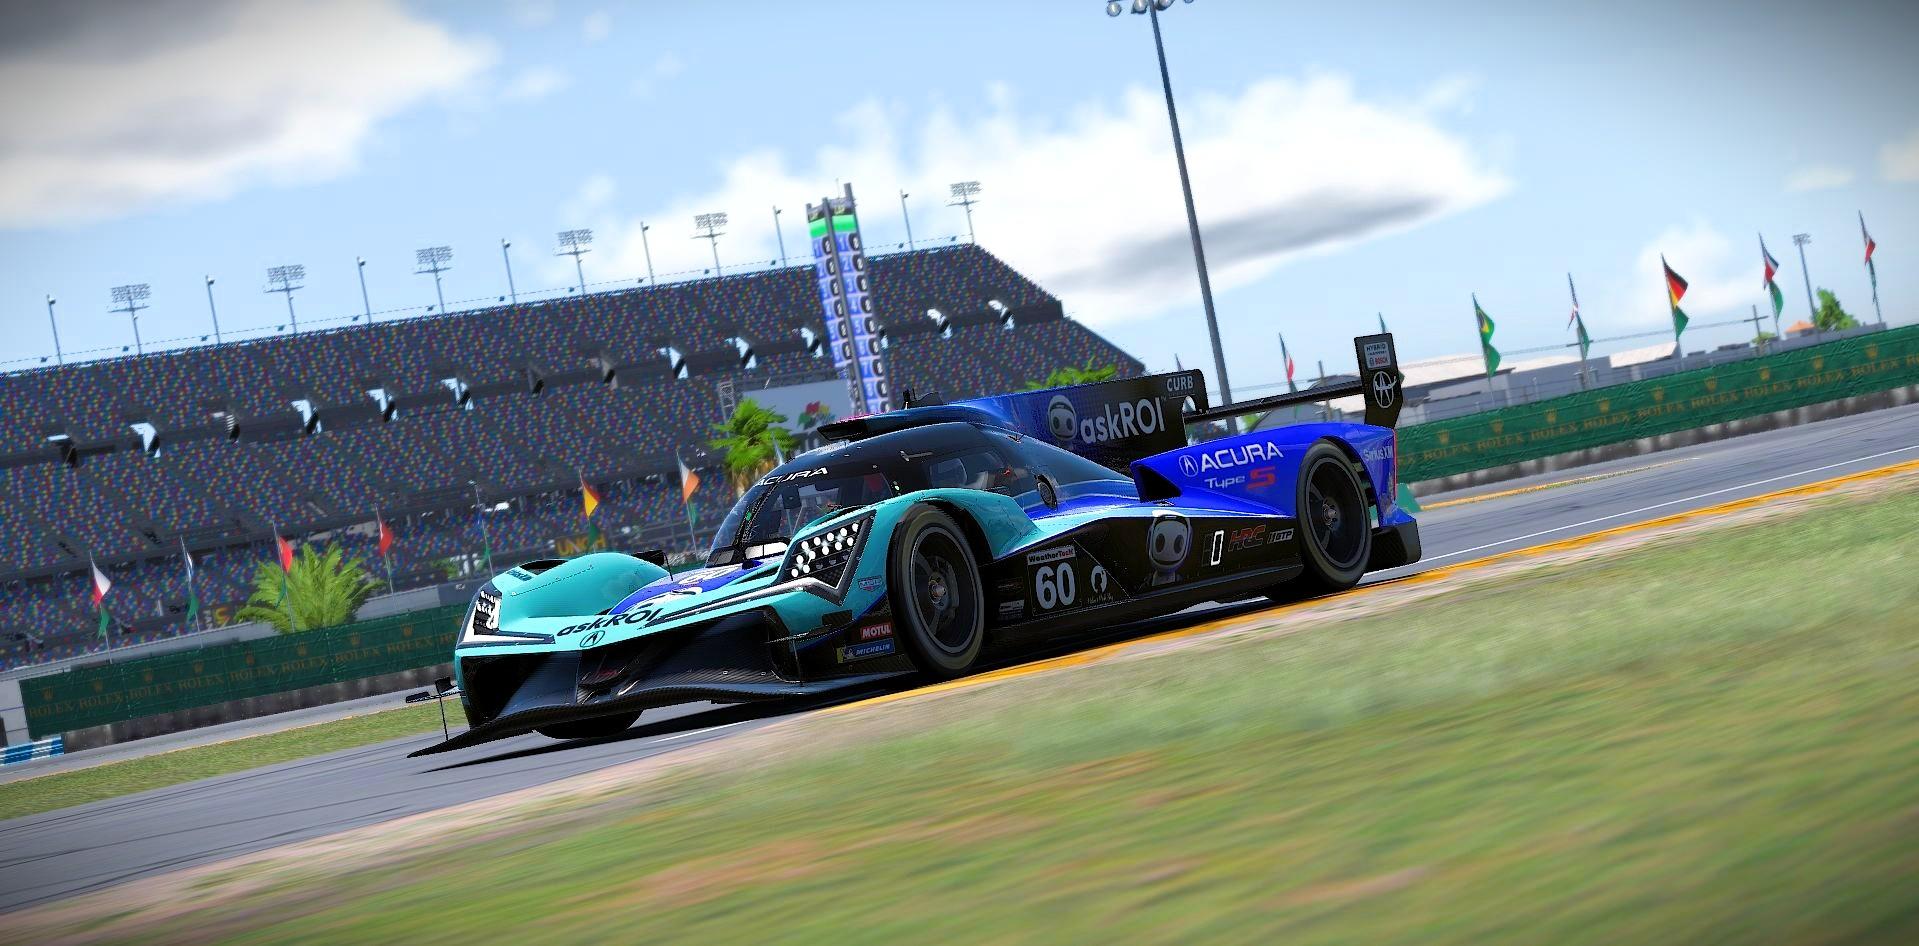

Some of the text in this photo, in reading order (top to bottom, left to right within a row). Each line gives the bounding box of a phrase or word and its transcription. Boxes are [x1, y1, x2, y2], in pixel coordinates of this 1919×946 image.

[1167, 375, 1194, 393] CURB
[1080, 396, 1165, 444] askROI
[1200, 441, 1284, 473] ACURA
[756, 466, 829, 486] ACURA
[1204, 466, 1277, 490] Type S
[1227, 524, 1267, 552] HRC
[1028, 549, 1074, 564] WeatherTech
[1035, 562, 1076, 610] 60
[556, 607, 664, 638] askROI
[862, 622, 891, 639] MOTUL
[855, 643, 891, 656] MICHELIN
